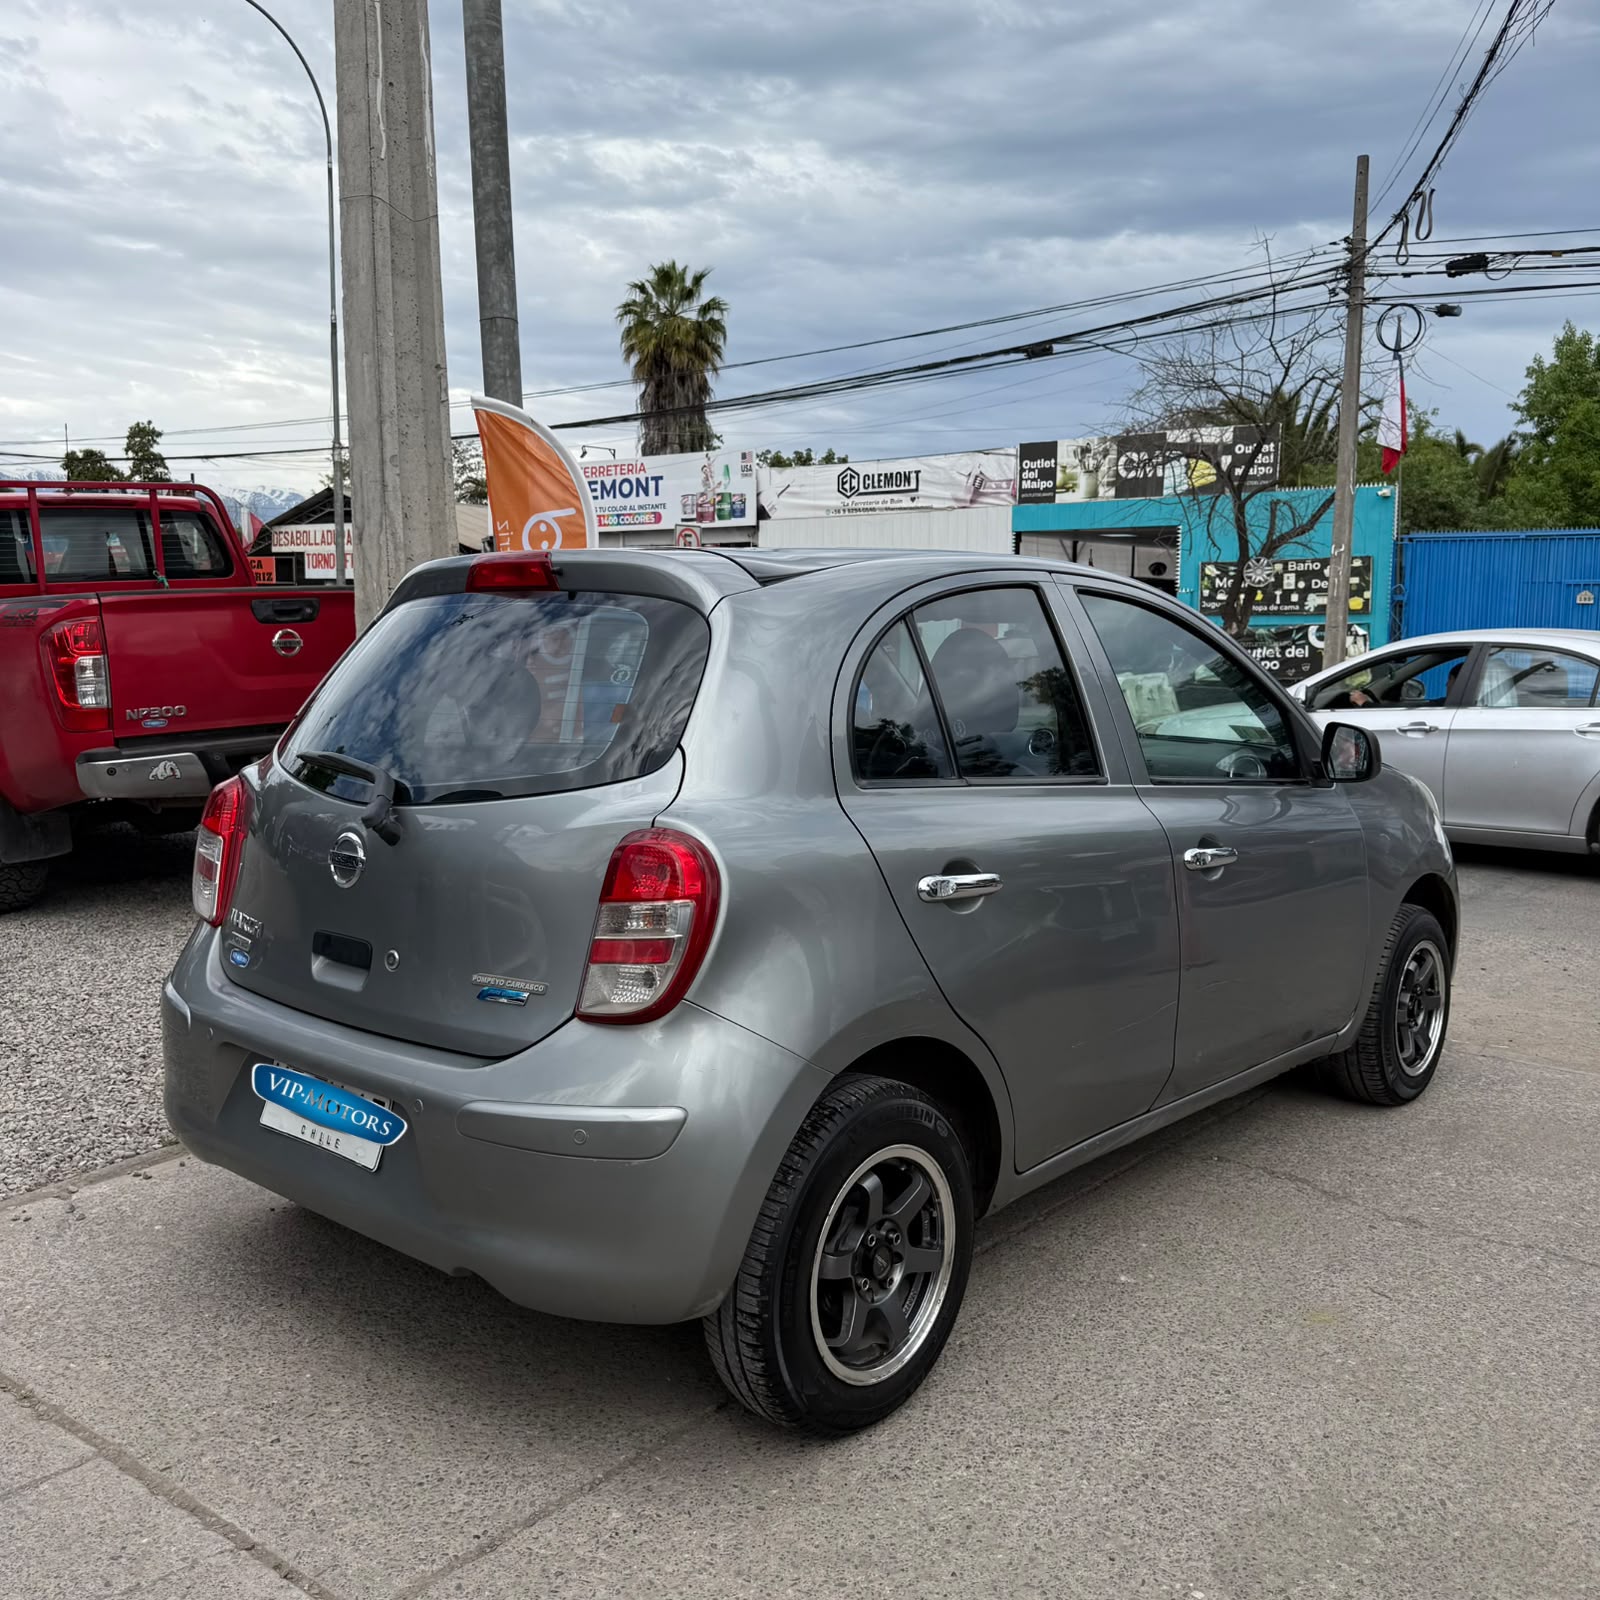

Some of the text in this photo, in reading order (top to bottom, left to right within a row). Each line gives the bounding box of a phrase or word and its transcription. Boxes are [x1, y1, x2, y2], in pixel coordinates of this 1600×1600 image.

[581, 460, 647, 479] ERRETERÍA
[740, 464, 753, 473] USA
[1022, 458, 1056, 469] Outlet
[862, 470, 921, 491] CLEMONT
[1022, 469, 1039, 479] del
[588, 475, 664, 501] EMONT
[1021, 478, 1054, 491] Maipo
[608, 505, 628, 513] COLOR
[628, 504, 637, 512] AL
[637, 502, 667, 511] INSTANTE
[619, 514, 656, 525] COLORES
[272, 529, 352, 547] DESABOLLADA
[306, 553, 336, 569] TORNO
[1287, 560, 1321, 571] Baño
[1247, 645, 1309, 660] utlet del
[125, 704, 188, 721] NP300
[472, 974, 545, 992] POMPEYO CARRASCO
